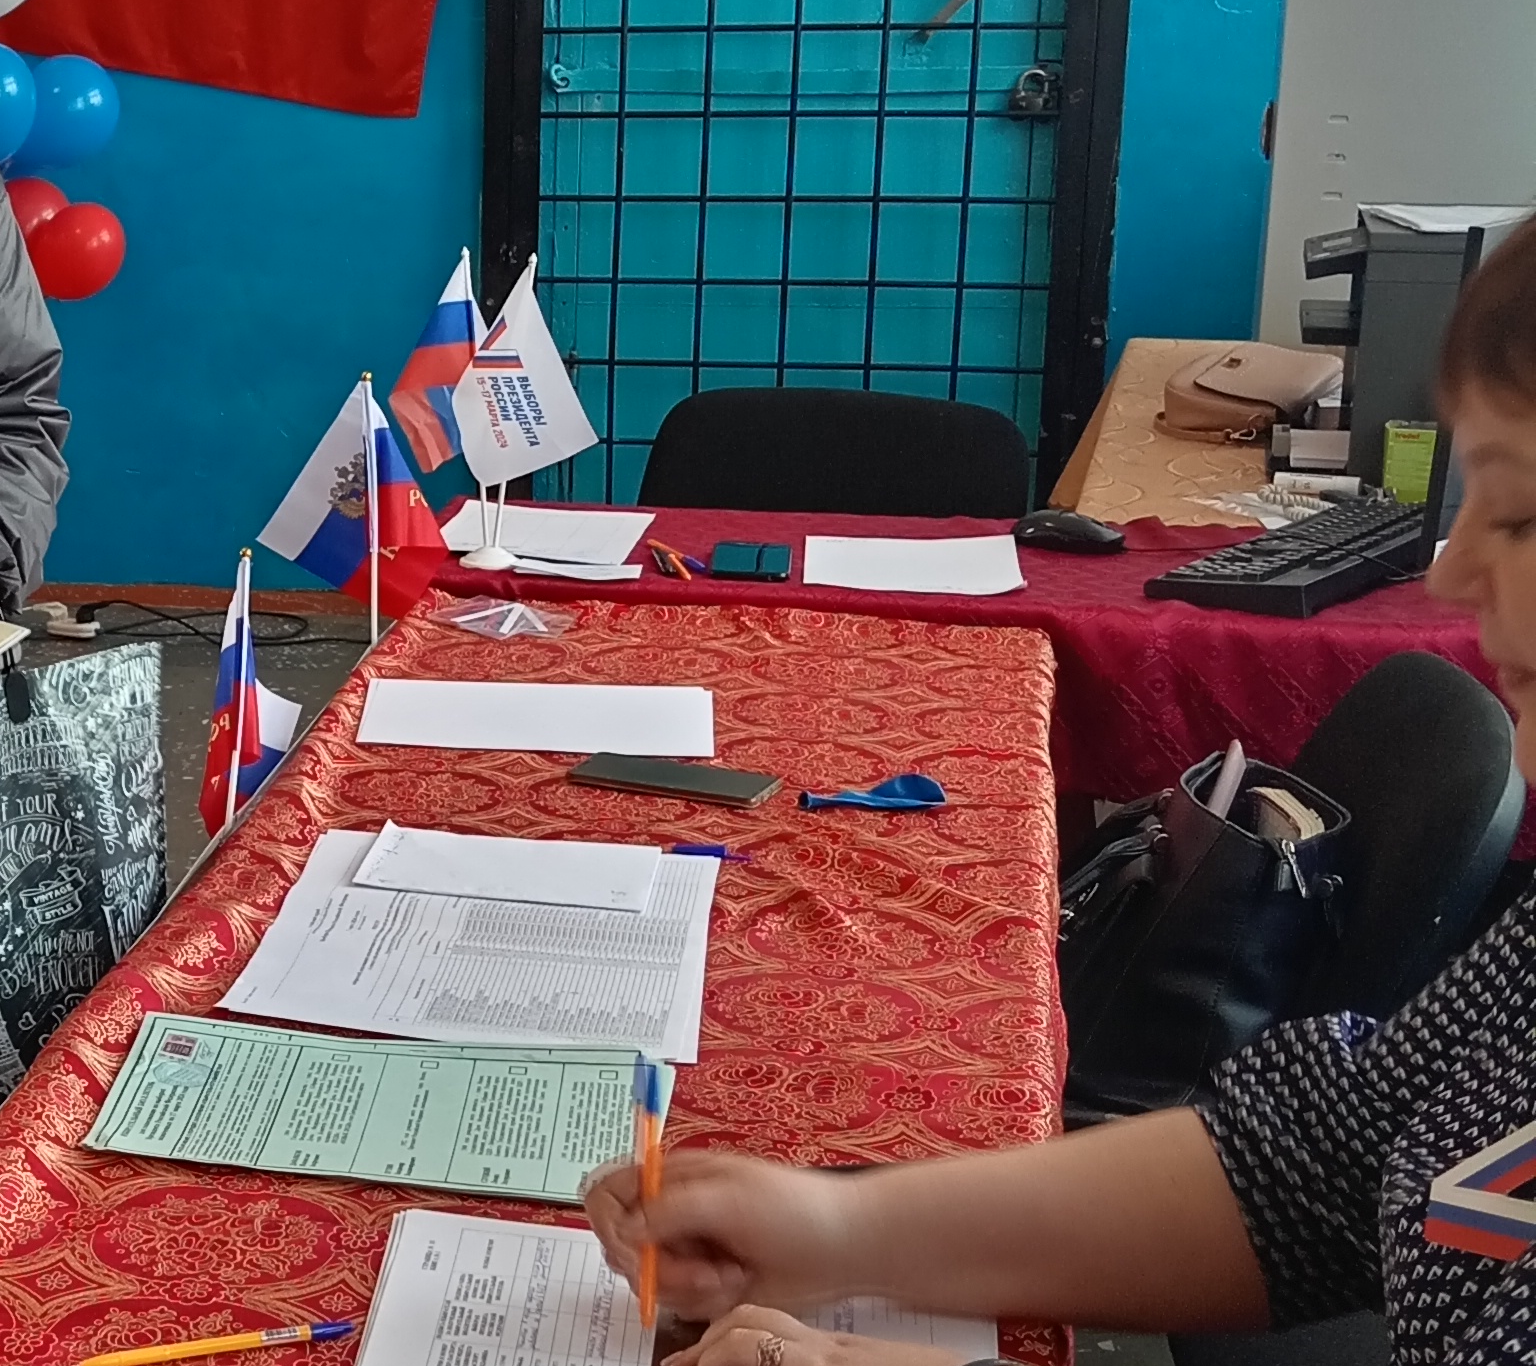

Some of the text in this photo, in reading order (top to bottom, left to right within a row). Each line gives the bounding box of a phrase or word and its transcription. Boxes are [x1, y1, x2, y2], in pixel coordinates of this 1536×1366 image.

[488, 376, 513, 422] РОССИИ
[500, 376, 540, 447] ПРЕЗИДЕНТА
[517, 376, 547, 426] ВЫБОРЫ
[485, 400, 500, 428] МАРТА
[493, 429, 510, 449] 2024
[16, 793, 61, 817] YOUR
[33, 882, 75, 904] VINTAGE
[45, 903, 75, 920] STYLE
